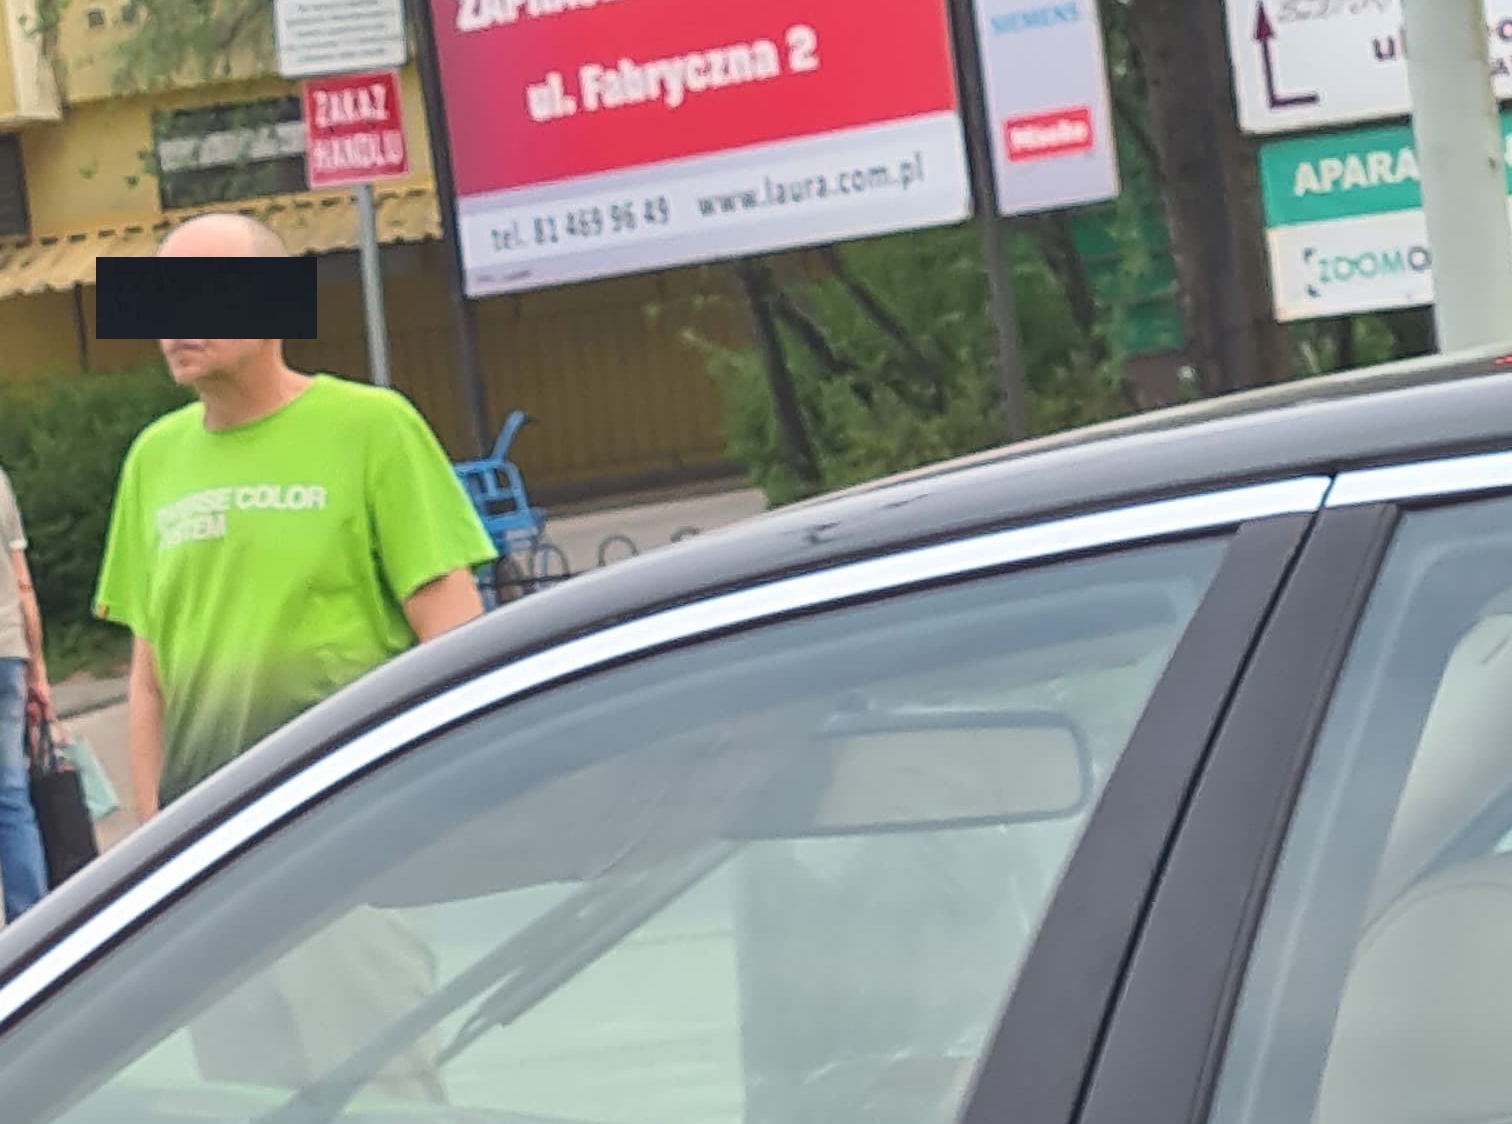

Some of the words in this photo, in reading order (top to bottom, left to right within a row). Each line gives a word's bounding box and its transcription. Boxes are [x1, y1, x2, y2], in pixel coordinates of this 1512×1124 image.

[525, 71, 577, 121] ul.
[578, 38, 780, 112] Fabryczna
[785, 23, 821, 73] 2
[312, 83, 389, 129] ZAKAZ
[1294, 146, 1421, 197] APARA
[534, 215, 559, 244] 81
[609, 201, 637, 232] 96
[643, 195, 670, 225] 49
[697, 151, 925, 217] www.laura.com.pl
[235, 483, 328, 512] COLOR
